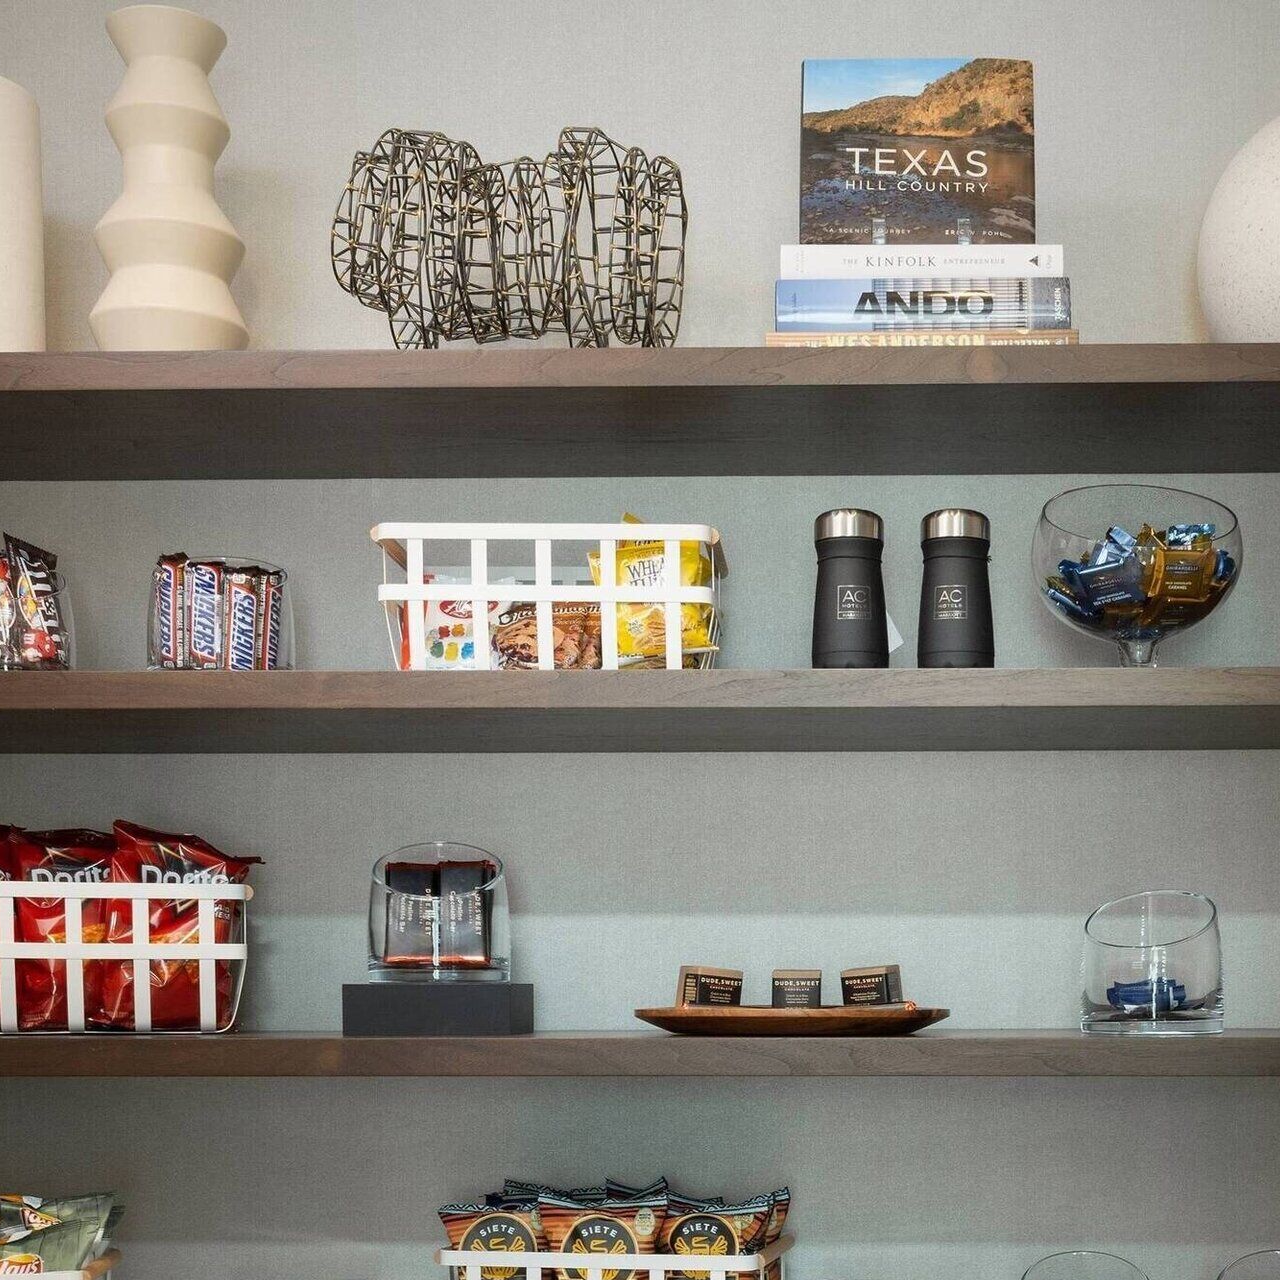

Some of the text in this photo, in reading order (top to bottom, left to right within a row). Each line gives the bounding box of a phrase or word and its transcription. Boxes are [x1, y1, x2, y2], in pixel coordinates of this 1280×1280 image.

[846, 148, 988, 177] TEXAS
[846, 180, 989, 194] HILL COUNTRY
[865, 255, 937, 267] KINFOLK
[853, 289, 994, 317] ANDO
[842, 590, 867, 603] AC
[938, 589, 962, 603] AC
[193, 566, 217, 657] SNICKERS
[268, 590, 281, 670] NICKERS
[479, 1223, 517, 1239] SIETE
[580, 1224, 618, 1239] SIETE
[682, 1223, 719, 1236] SIETE
